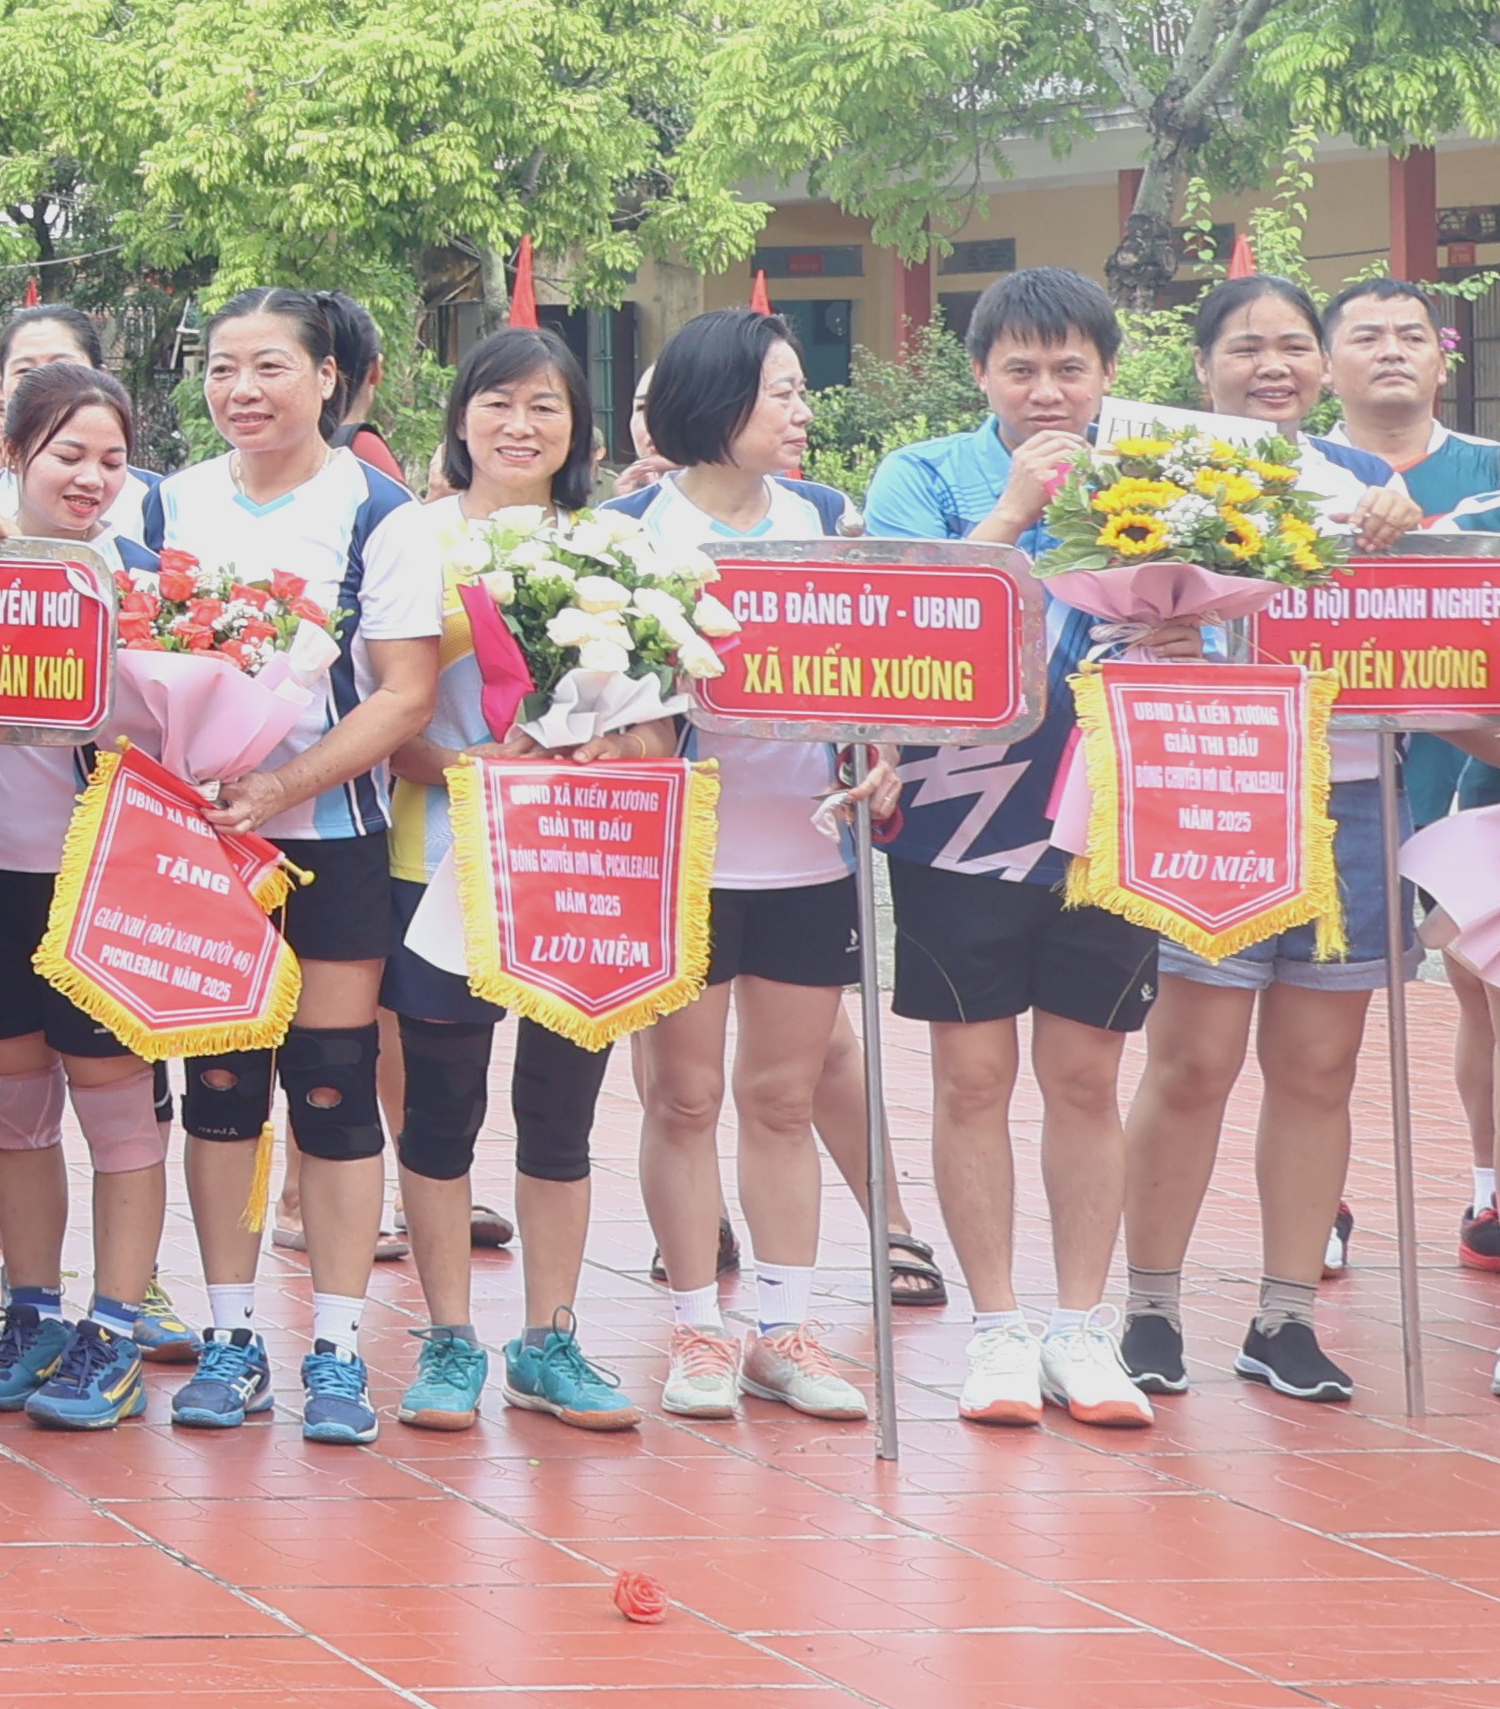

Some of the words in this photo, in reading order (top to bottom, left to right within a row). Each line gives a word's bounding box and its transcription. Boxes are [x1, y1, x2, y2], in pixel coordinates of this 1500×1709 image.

[42, 589, 80, 628] HƠI
[733, 590, 778, 623] CLB
[786, 581, 852, 625] ĐẢNG
[859, 583, 890, 626] ỦY
[913, 596, 981, 630] UBND
[1268, 588, 1307, 619] CLB
[1313, 581, 1349, 626] HỘI
[1355, 587, 1427, 619] DOANH
[34, 648, 83, 701] KHÔI
[743, 646, 784, 695] XÃ
[792, 642, 862, 697] KIẾN
[871, 655, 973, 701] XƯƠNG
[1332, 637, 1394, 689] KIẾN
[1400, 645, 1488, 689] XƯƠNG
[1133, 702, 1174, 721] UBND
[1175, 700, 1195, 723] XÃ
[1164, 728, 1196, 753] GIẢI
[1199, 735, 1224, 755] THI
[126, 787, 164, 816] UBND
[553, 782, 573, 807] XÃ
[574, 783, 607, 809] KIẾN
[610, 788, 659, 812] XƯƠNG
[538, 810, 569, 836] GIẢI
[572, 819, 595, 840] THI
[599, 815, 632, 841] ĐẤU
[1179, 804, 1214, 831] NĂM
[1217, 810, 1252, 832] 2025
[156, 853, 231, 895] TẶNG
[606, 855, 659, 879] PICKLEBALL
[1150, 850, 1208, 879] LƯU
[1211, 850, 1276, 890] NIỆM
[555, 888, 587, 913] NĂM
[589, 895, 621, 917] 2025
[531, 933, 585, 963] LƯU
[590, 934, 650, 973] NIỆM
[99, 944, 169, 985] PICKLEBALL
[171, 965, 201, 993] NĂM
[201, 977, 231, 1002] 2025
